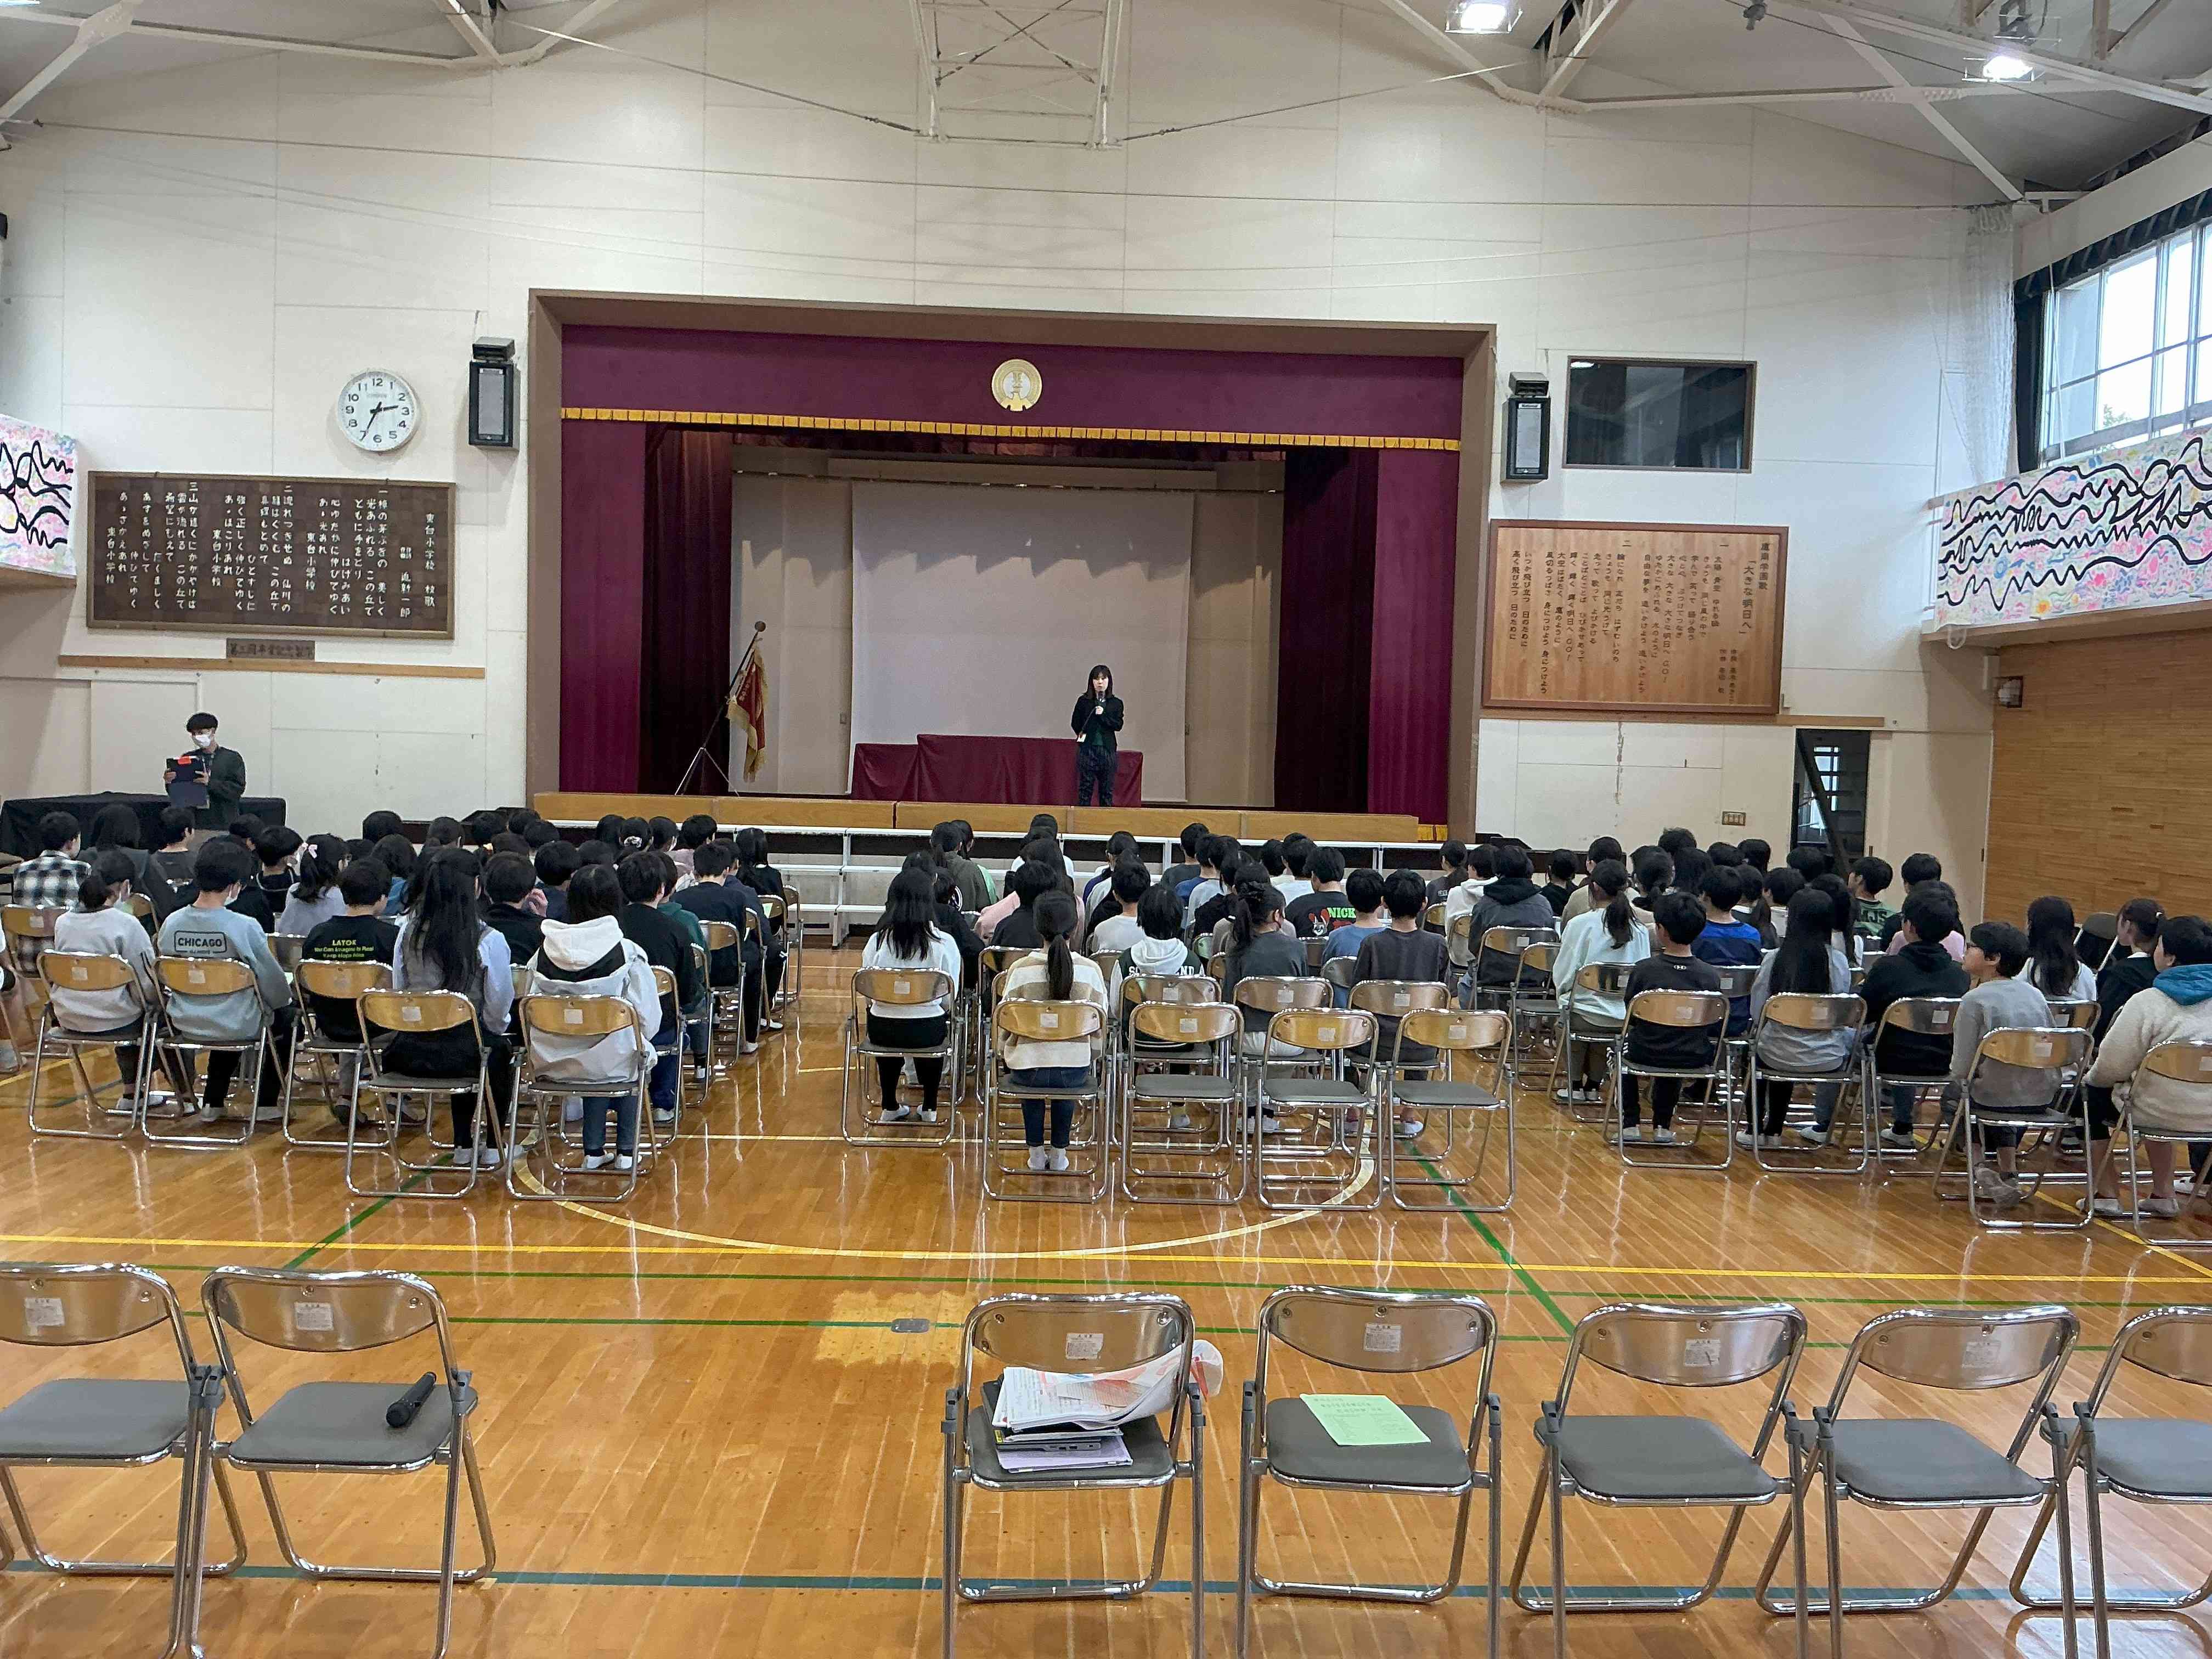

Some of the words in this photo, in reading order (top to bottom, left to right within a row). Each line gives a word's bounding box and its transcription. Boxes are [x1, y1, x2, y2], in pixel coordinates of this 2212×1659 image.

[373, 378, 383, 386] 12
[398, 393, 405, 401] 2
[401, 407, 409, 415] 3
[348, 419, 358, 427] 8
[359, 430, 366, 442] 7
[373, 435, 382, 443] 6
[388, 431, 397, 439] 5
[1327, 907, 1357, 918] NICK
[178, 937, 222, 947] CHICAGO
